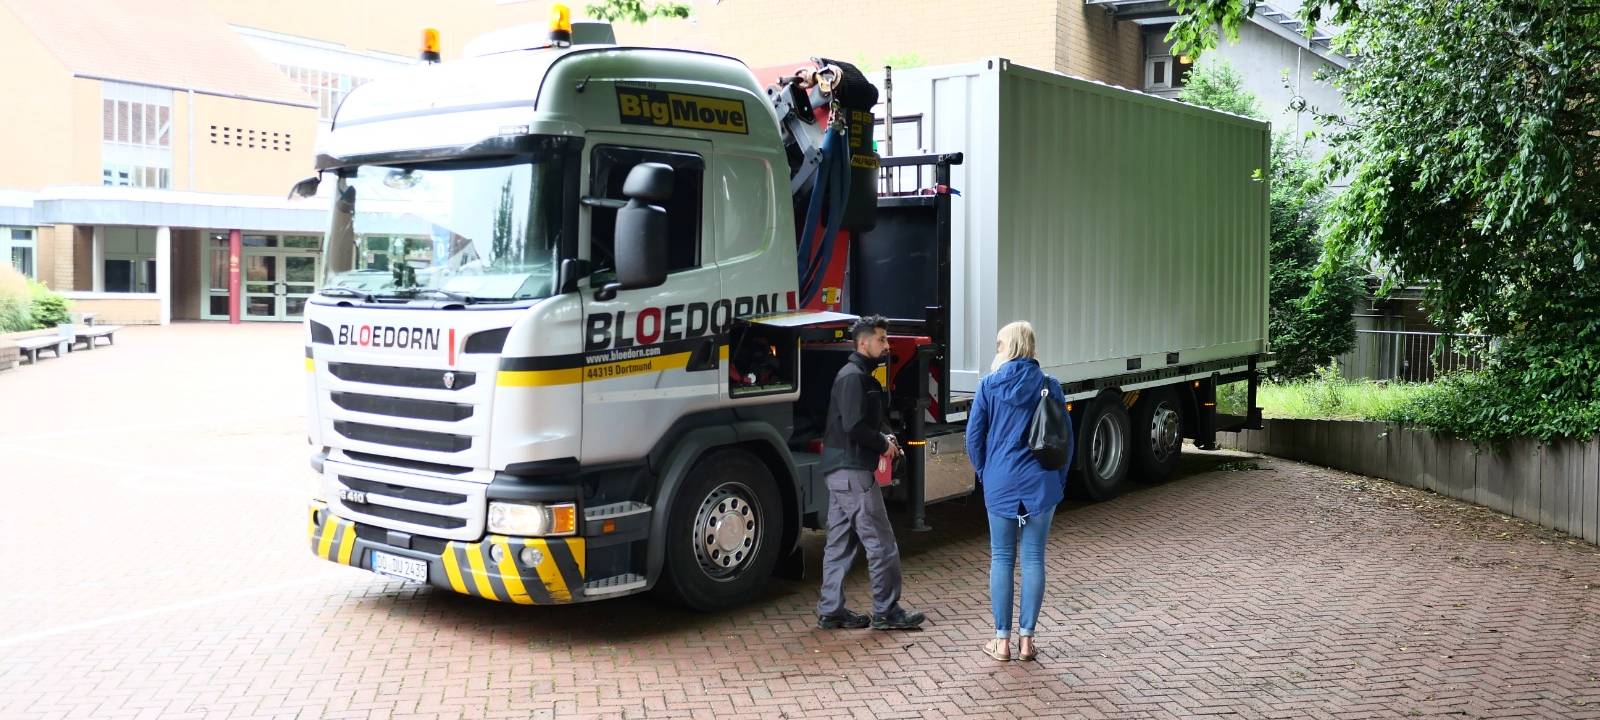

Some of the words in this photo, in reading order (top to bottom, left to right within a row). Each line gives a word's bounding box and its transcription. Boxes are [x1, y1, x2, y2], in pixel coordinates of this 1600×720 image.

[338, 324, 441, 350] BLOEDORN
[586, 347, 661, 364] www.bloedorn.com
[587, 365, 613, 379] 44319
[615, 360, 652, 375] Dortmund
